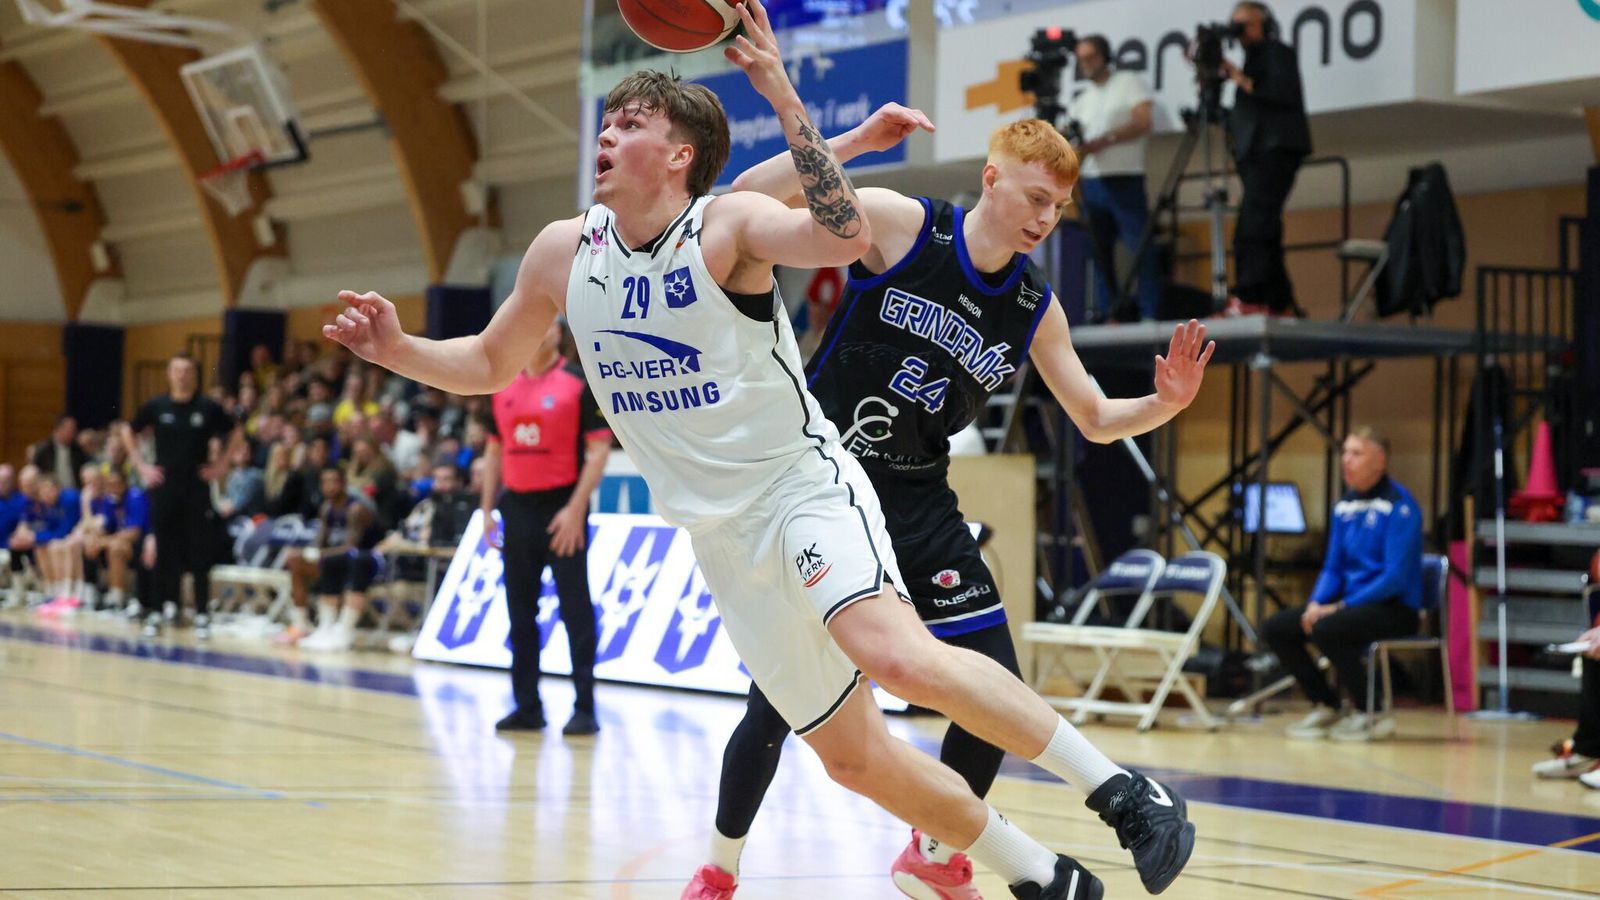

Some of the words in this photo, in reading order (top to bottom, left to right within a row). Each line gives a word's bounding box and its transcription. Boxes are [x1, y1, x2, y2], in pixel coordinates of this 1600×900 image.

[621, 275, 650, 319] 29
[888, 355, 951, 414] 24
[795, 542, 822, 576] PK
[802, 558, 826, 582] VERK
[933, 584, 991, 608] bus4u
